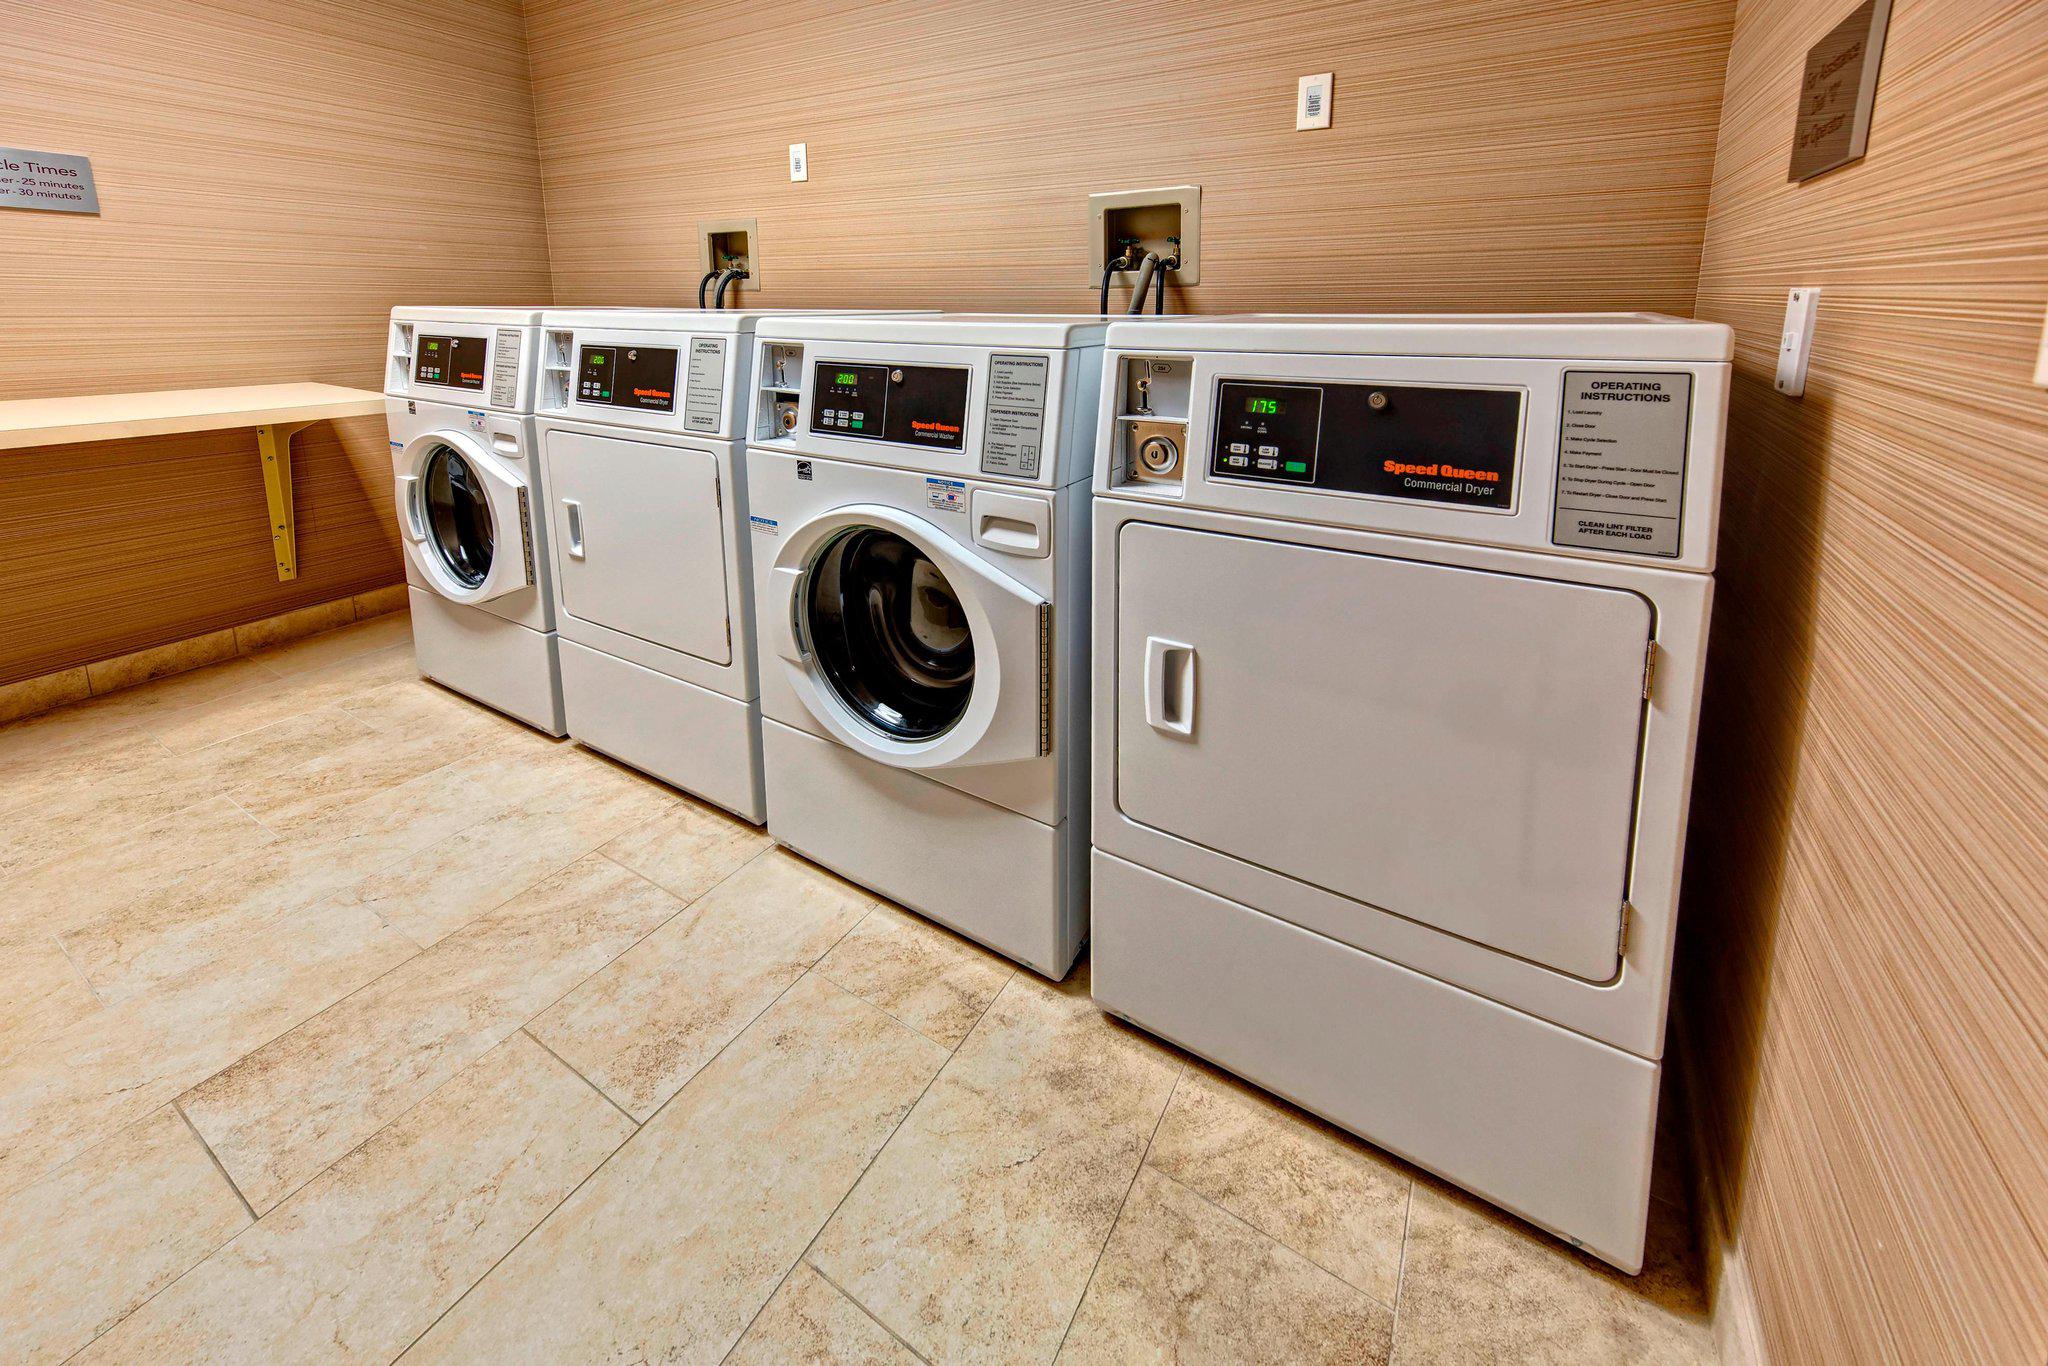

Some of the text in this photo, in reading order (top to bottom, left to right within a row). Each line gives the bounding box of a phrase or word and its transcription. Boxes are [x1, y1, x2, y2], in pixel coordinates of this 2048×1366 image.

[23, 162, 78, 177] Times
[22, 177, 36, 186] 25
[39, 181, 85, 190] minutes
[18, 188, 33, 196] 30
[36, 191, 82, 200] minutes
[837, 374, 854, 384] 200
[1591, 382, 1661, 391] OPERATING
[634, 388, 670, 398] Speed Queen
[1581, 392, 1671, 402] INSTRUCTIONS
[1252, 400, 1276, 414] 175
[912, 421, 959, 432] Speed Queen
[915, 430, 938, 438] Commercial
[1384, 460, 1499, 481] Speed Queen
[1404, 478, 1494, 496] Commercial Dryer
[1578, 520, 1604, 528] CLEAN
[1626, 525, 1653, 533] FILTER
[1578, 528, 1604, 536] AFTER
[1606, 530, 1627, 538] EACH
